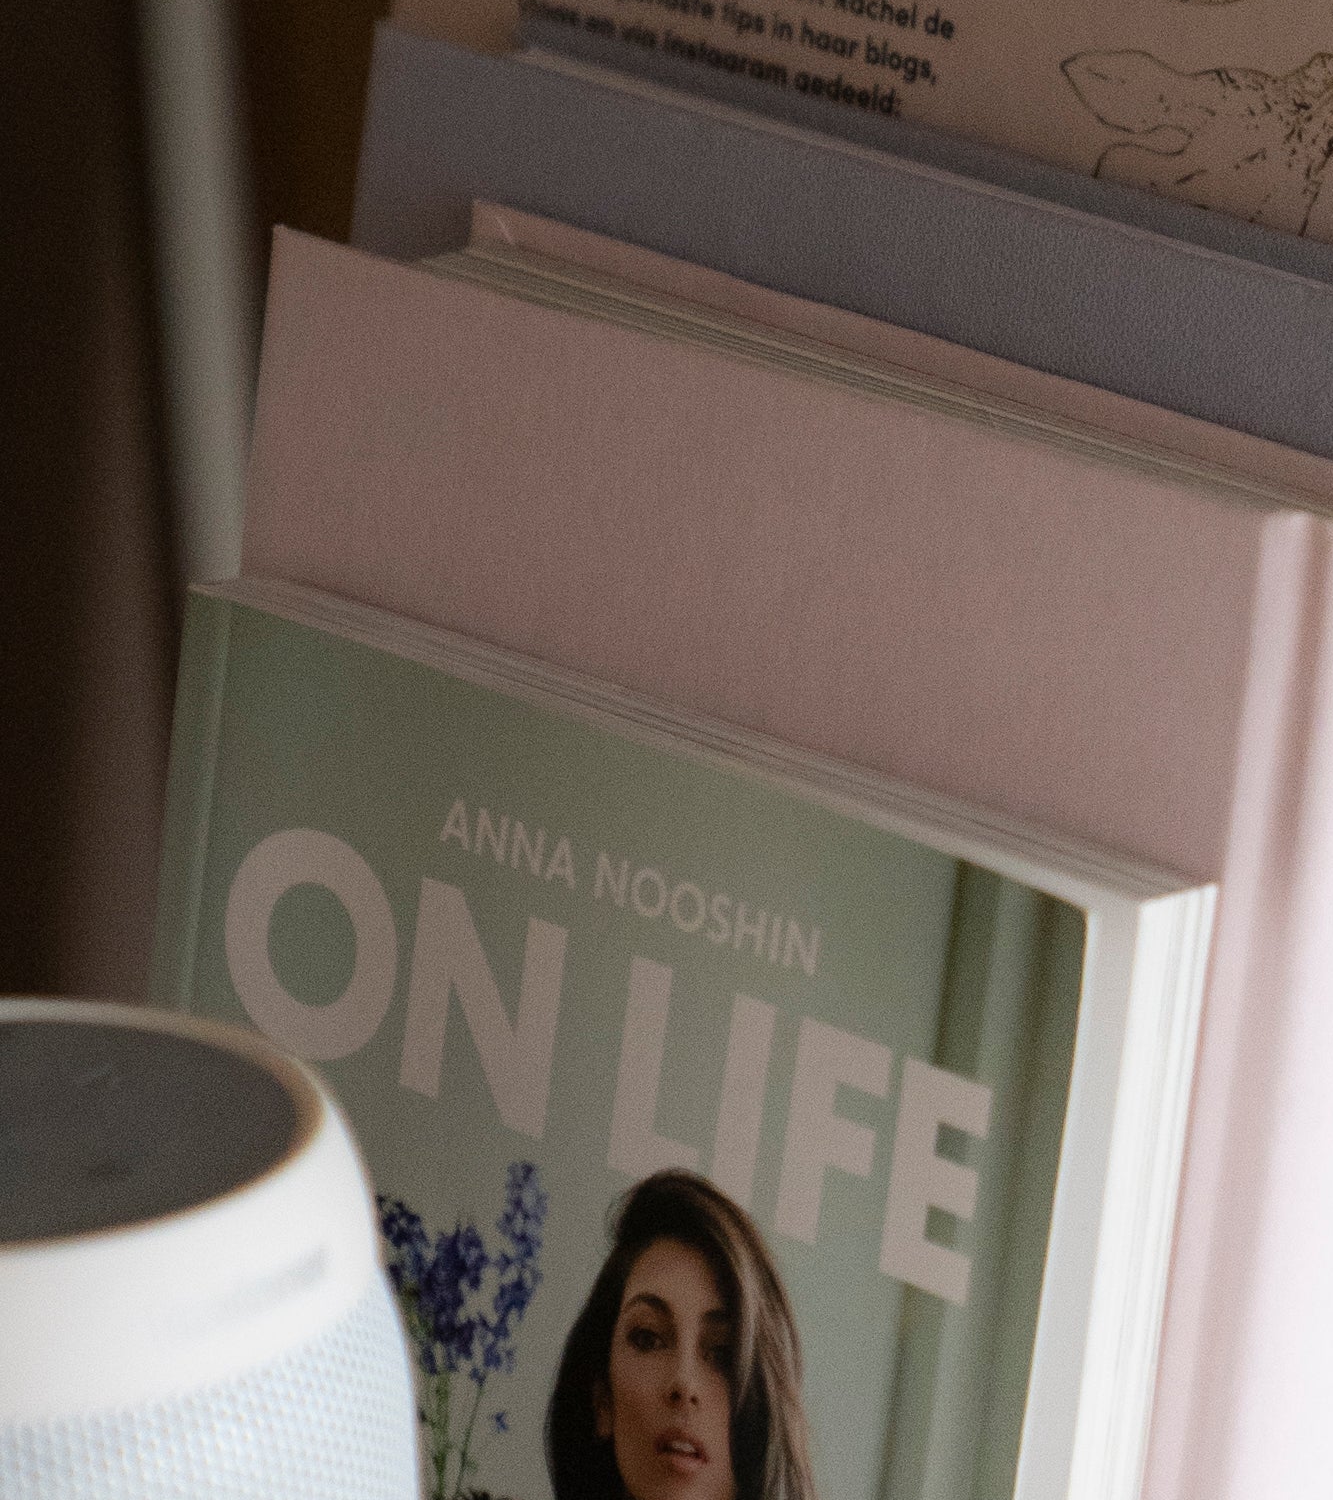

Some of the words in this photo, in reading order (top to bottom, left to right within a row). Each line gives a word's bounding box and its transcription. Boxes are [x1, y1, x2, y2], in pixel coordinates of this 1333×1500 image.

[721, 0, 765, 37] tips
[771, 8, 794, 41] in
[800, 17, 859, 60] haar
[864, 33, 938, 88] blogs,
[923, 6, 956, 41] de
[438, 797, 577, 892] ANNA
[594, 850, 823, 978] NOOSHIN
[223, 825, 569, 1143] ON
[605, 955, 994, 1301] LIFE
